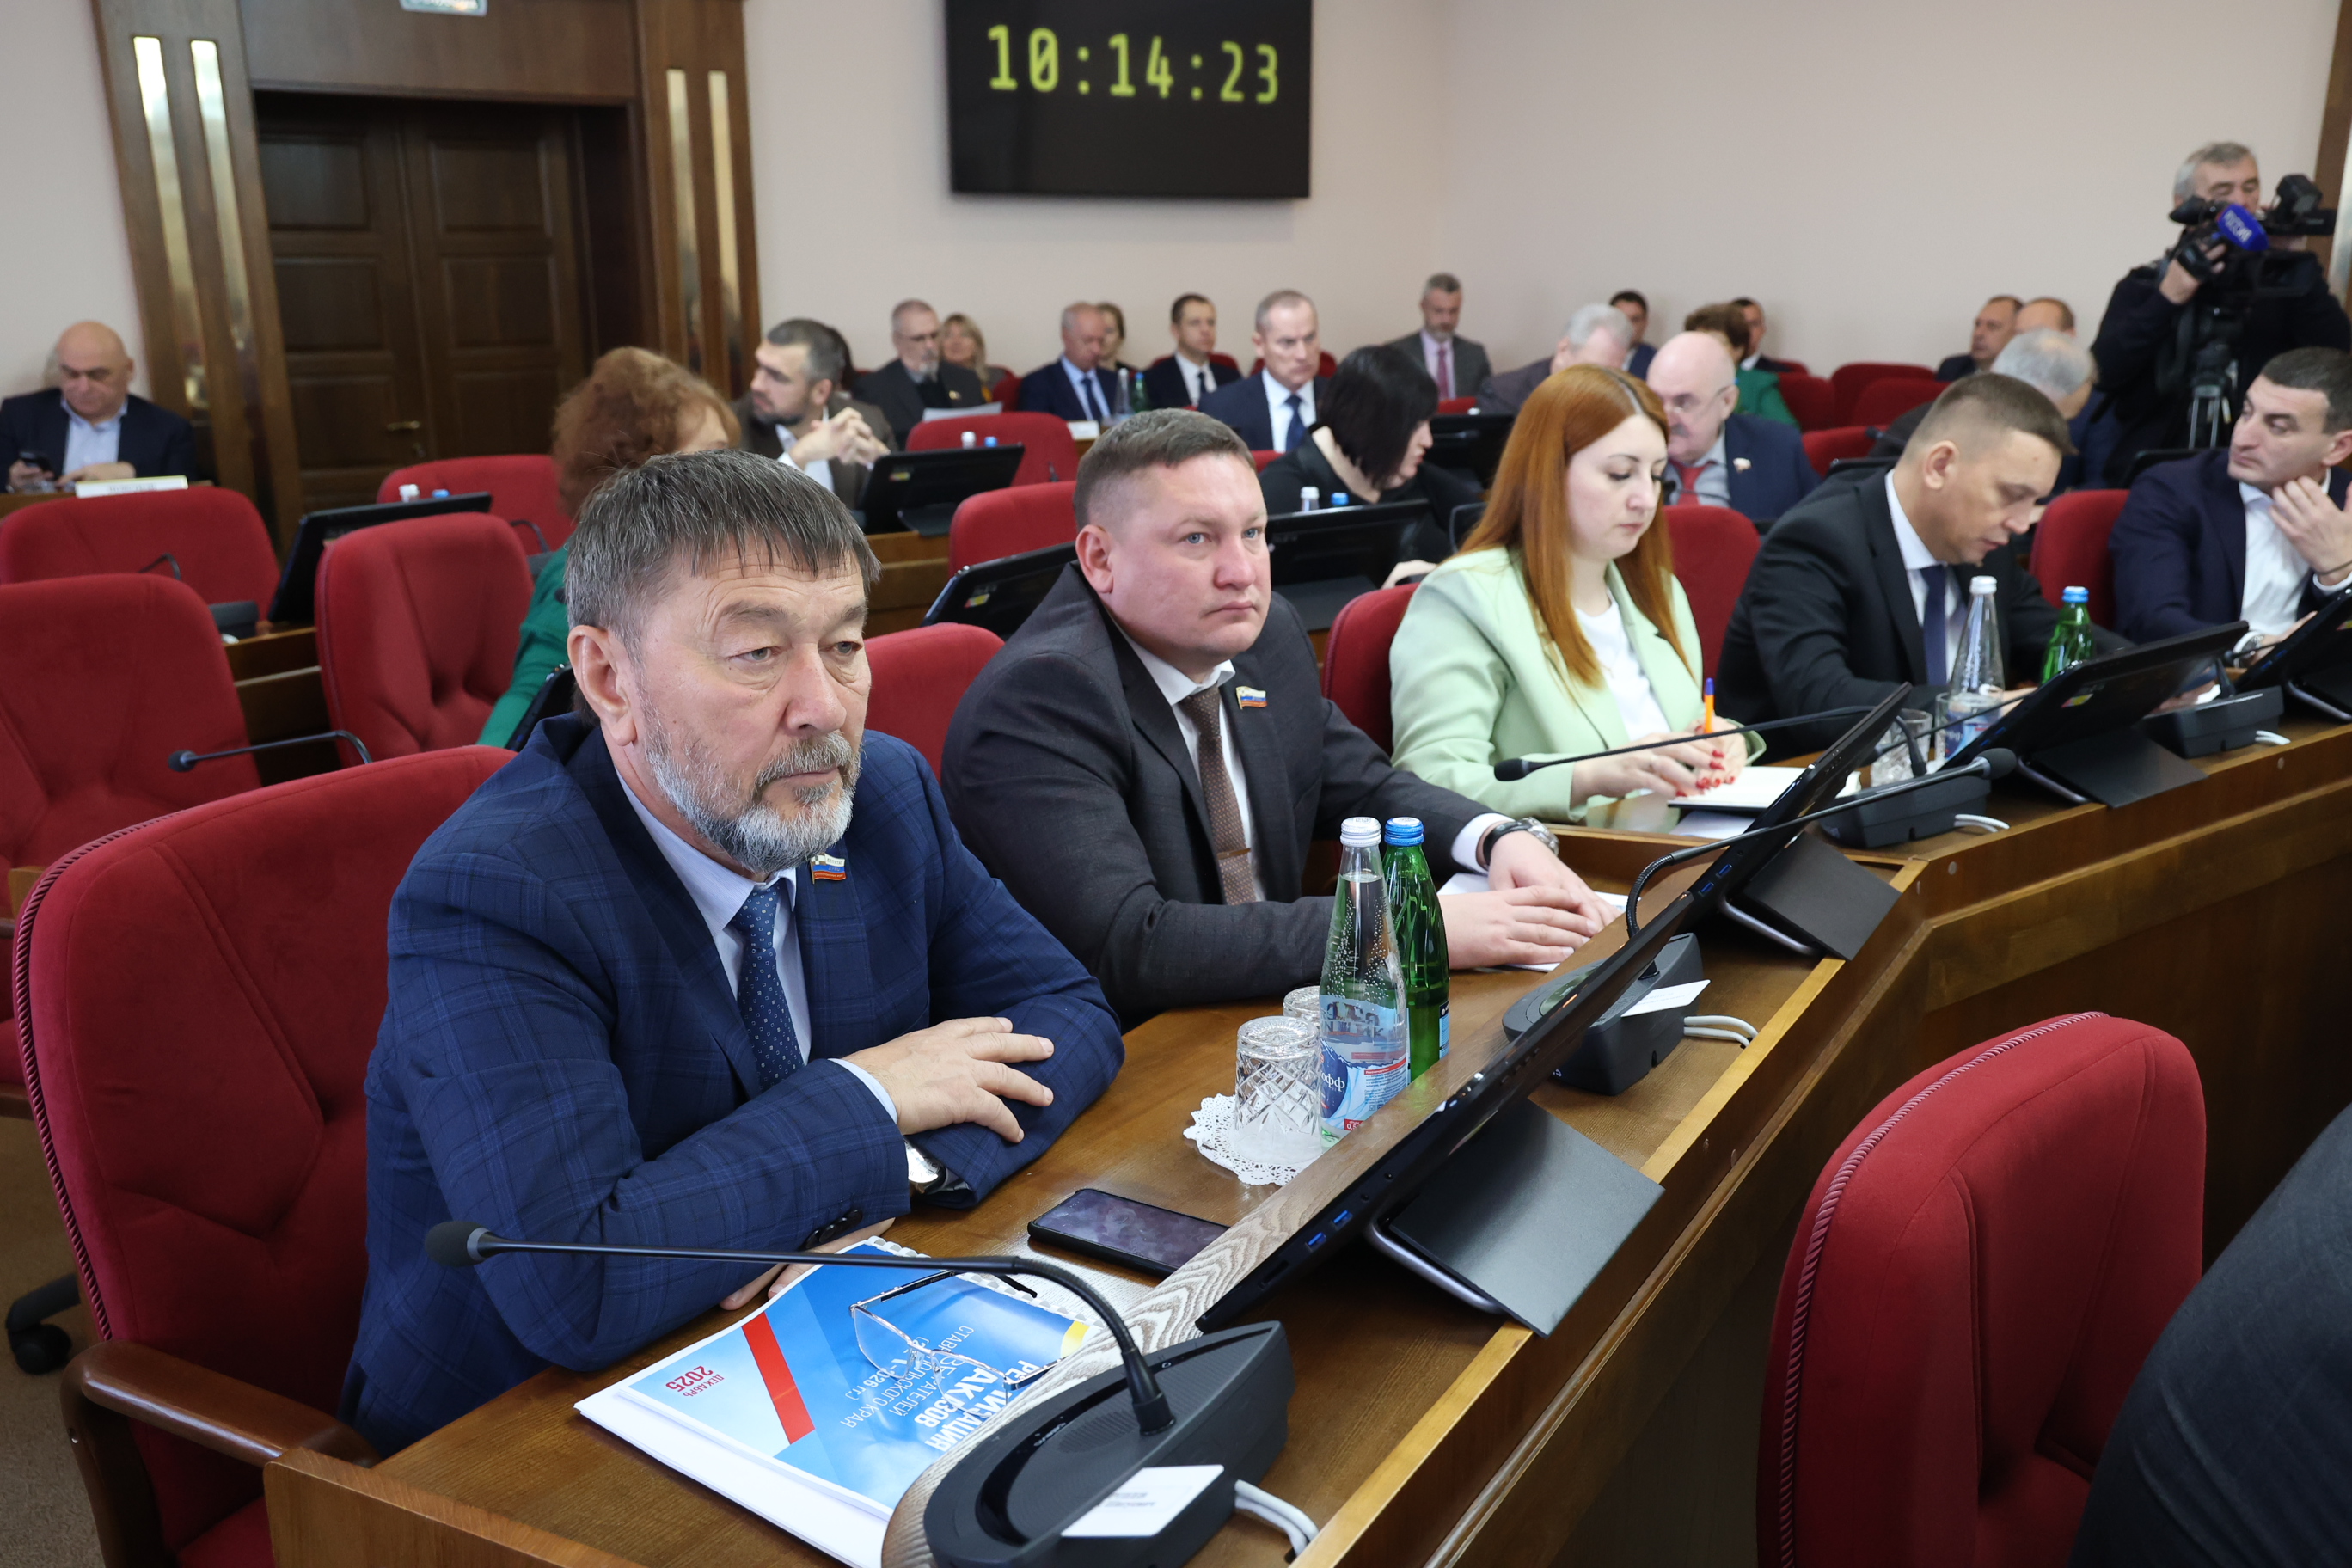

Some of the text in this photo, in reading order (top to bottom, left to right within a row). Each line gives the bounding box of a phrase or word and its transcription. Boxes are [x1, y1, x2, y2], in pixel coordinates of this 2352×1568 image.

[987, 24, 1279, 104] 10:14:23
[1321, 1072, 1345, 1093] офф
[665, 1365, 714, 1393] 2025
[683, 1374, 725, 1397] ДЕКАБРЬ
[839, 1402, 876, 1429] КРАЯ
